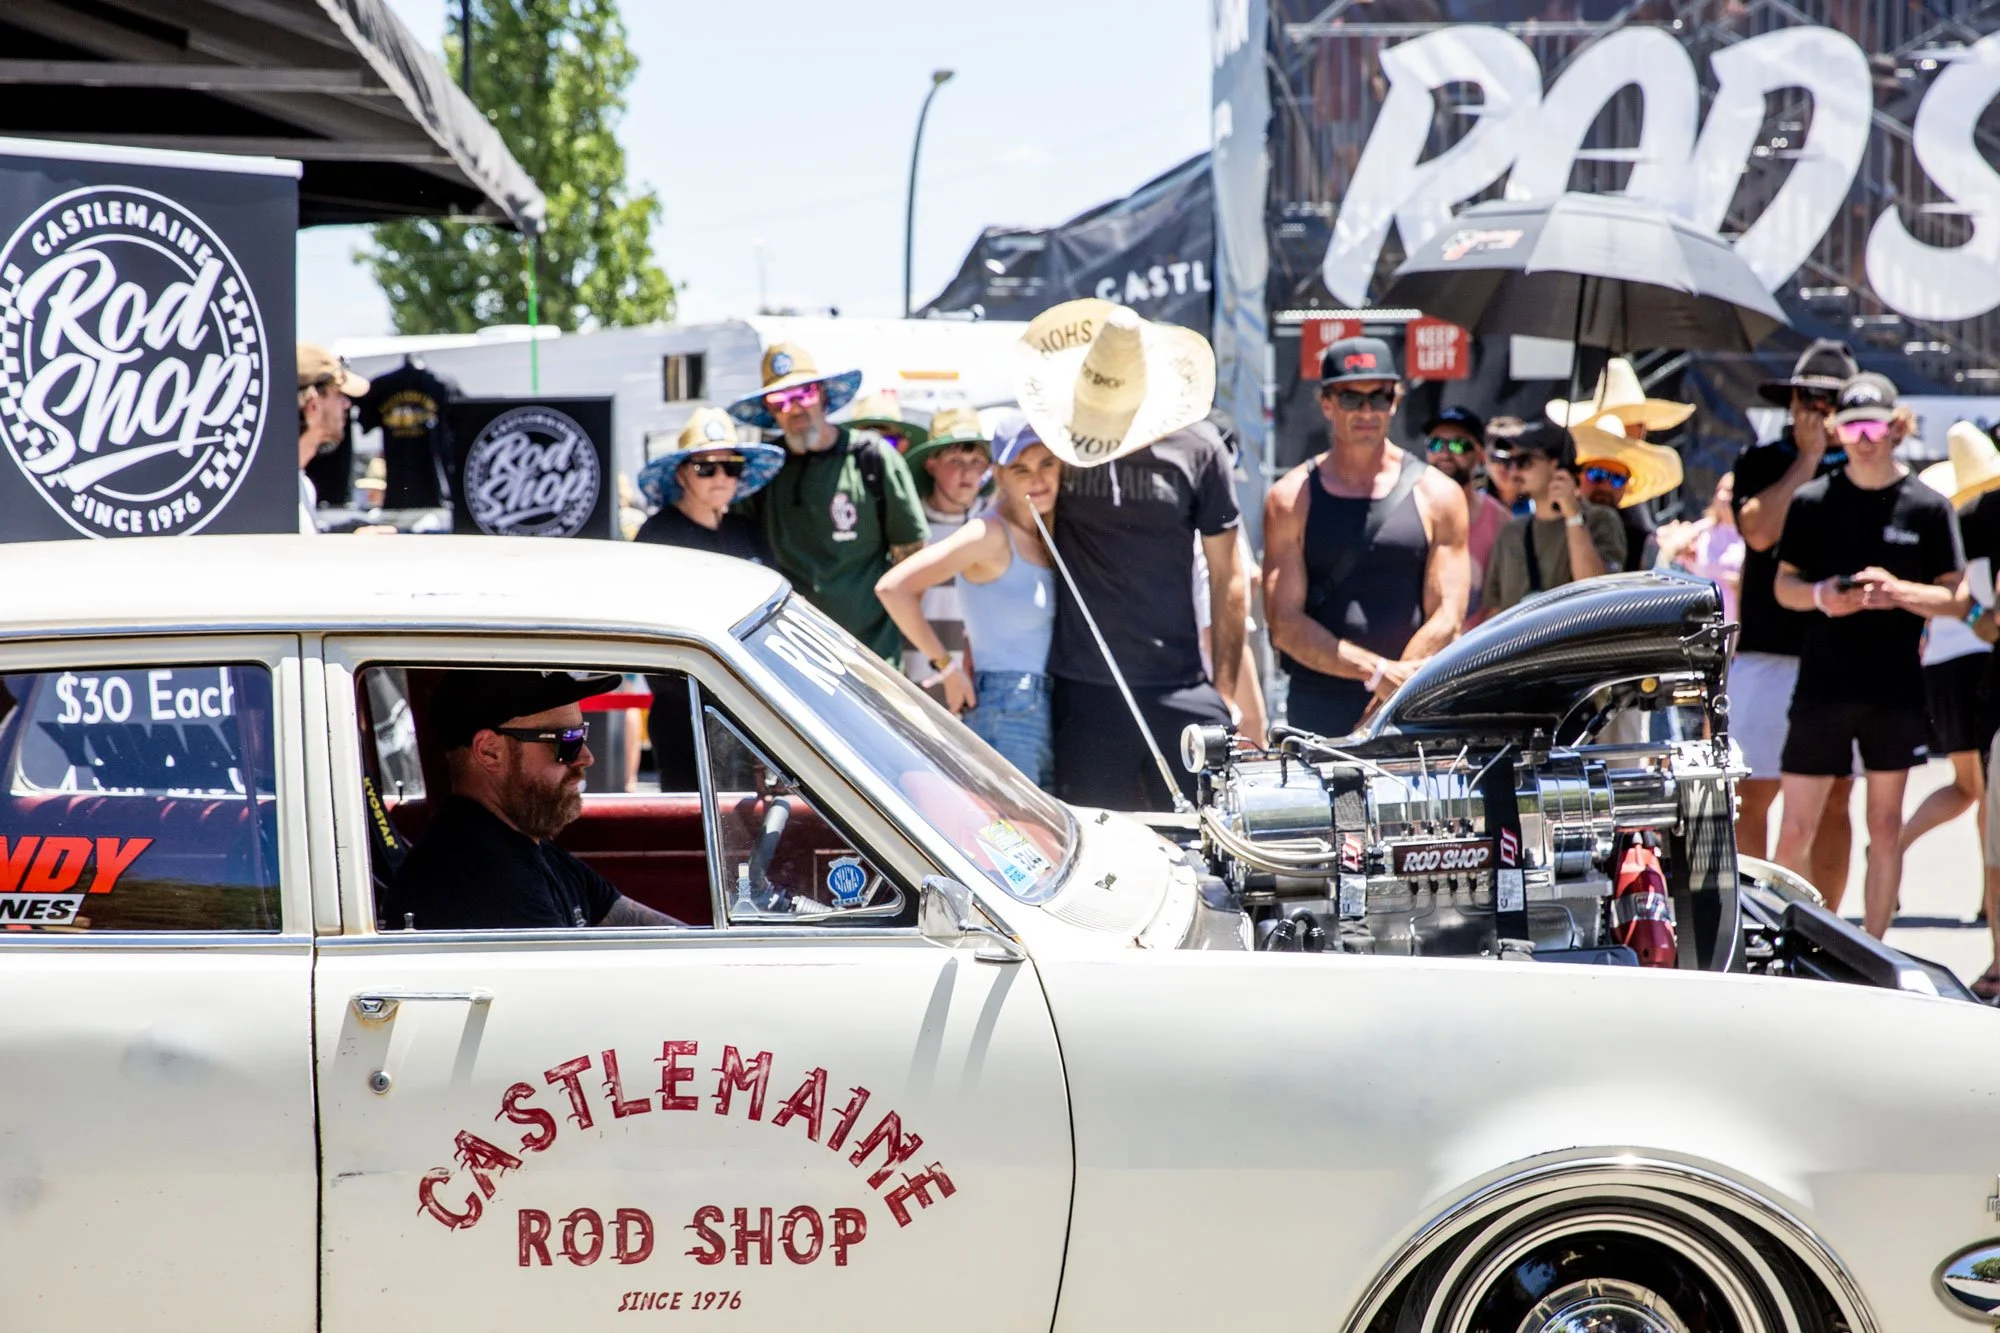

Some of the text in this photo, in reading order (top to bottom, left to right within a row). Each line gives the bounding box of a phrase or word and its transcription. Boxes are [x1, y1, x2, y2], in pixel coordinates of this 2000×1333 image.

[31, 200, 213, 267] CASTLEMAINE
[16, 248, 224, 364] Rod
[1095, 260, 1212, 305] CASTL
[20, 351, 251, 475] Shop
[480, 431, 577, 478] Rod
[71, 491, 202, 533] SINCE 1976
[476, 468, 591, 522] Shop
[56, 671, 133, 724] $30
[1402, 847, 1490, 872] ROD SHOP
[0, 899, 75, 920] NES
[416, 1040, 957, 1231] CASTLEMAINE
[518, 1205, 867, 1267] ROD SHOP
[618, 1290, 742, 1312] SINCE 1976
